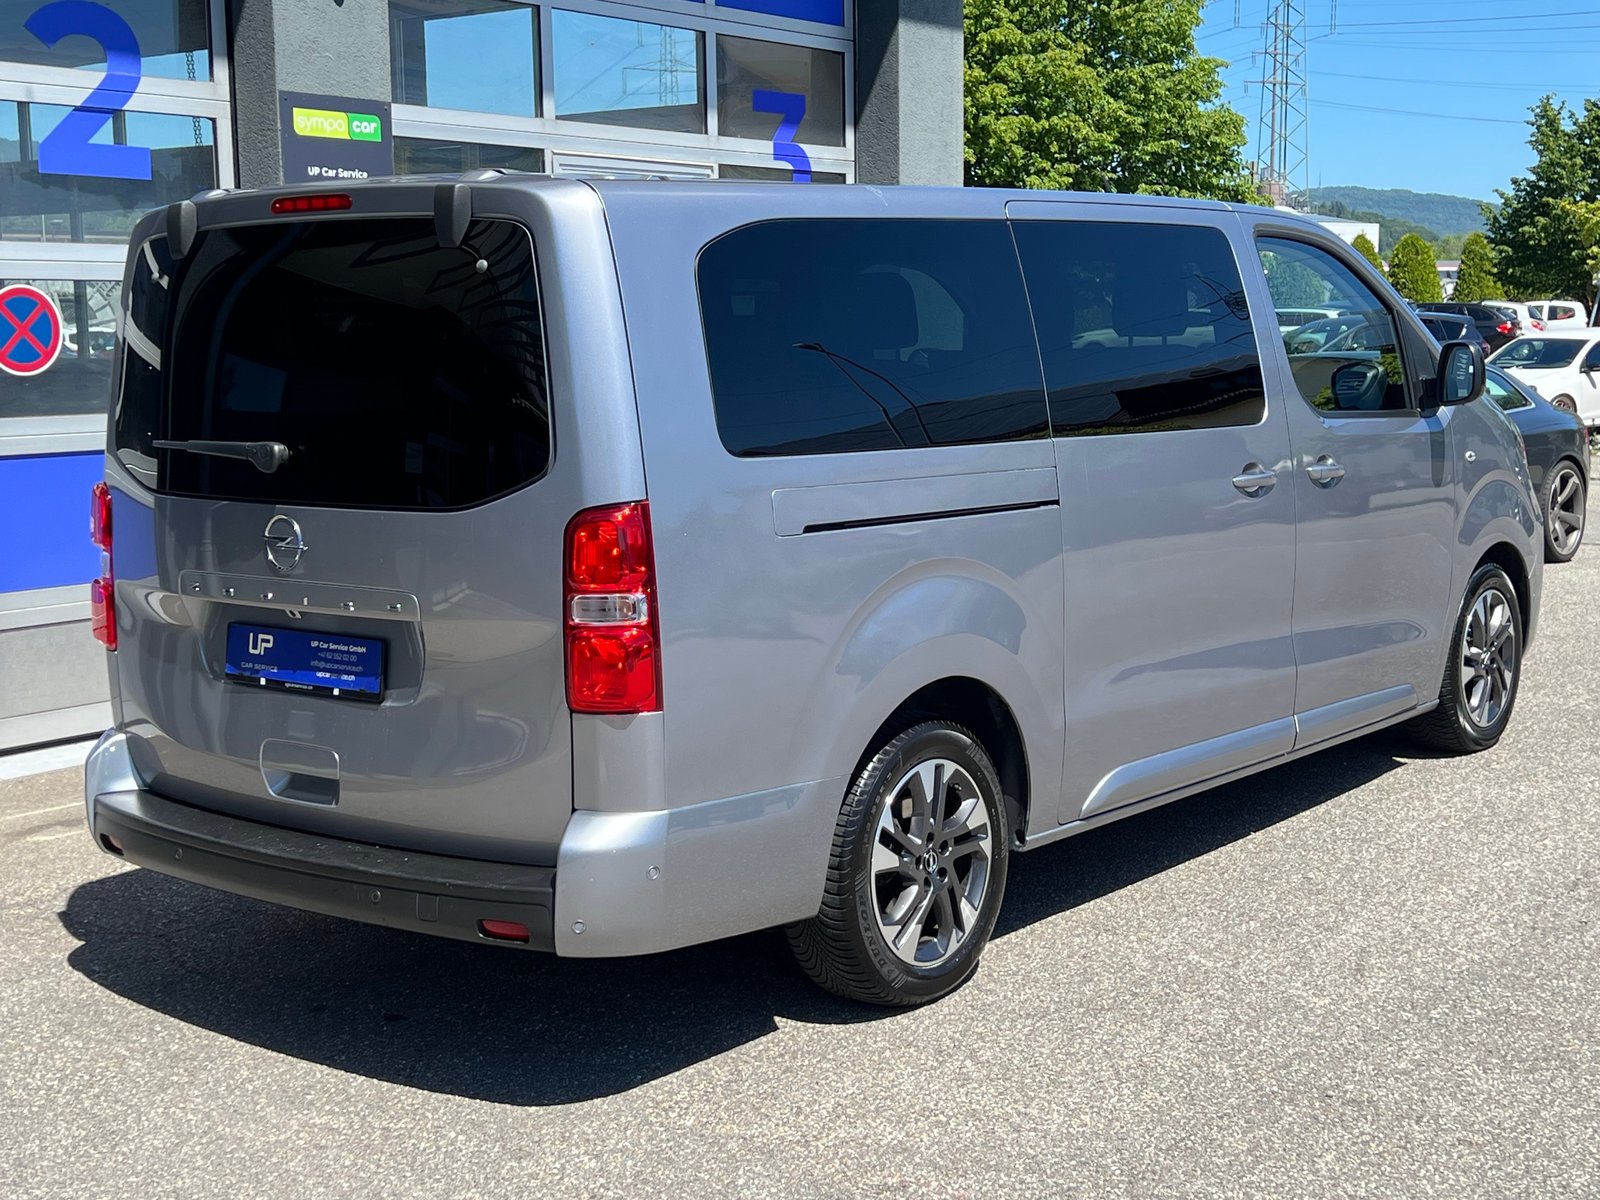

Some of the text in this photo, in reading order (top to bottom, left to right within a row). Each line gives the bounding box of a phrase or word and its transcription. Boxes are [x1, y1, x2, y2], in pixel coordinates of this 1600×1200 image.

[23, 0, 152, 181] 2
[352, 120, 377, 134] car
[307, 166, 368, 179] UP Car Service
[249, 632, 274, 655] UP
[310, 640, 366, 653] UP Car Service GmbH
[241, 661, 253, 669] CAR
